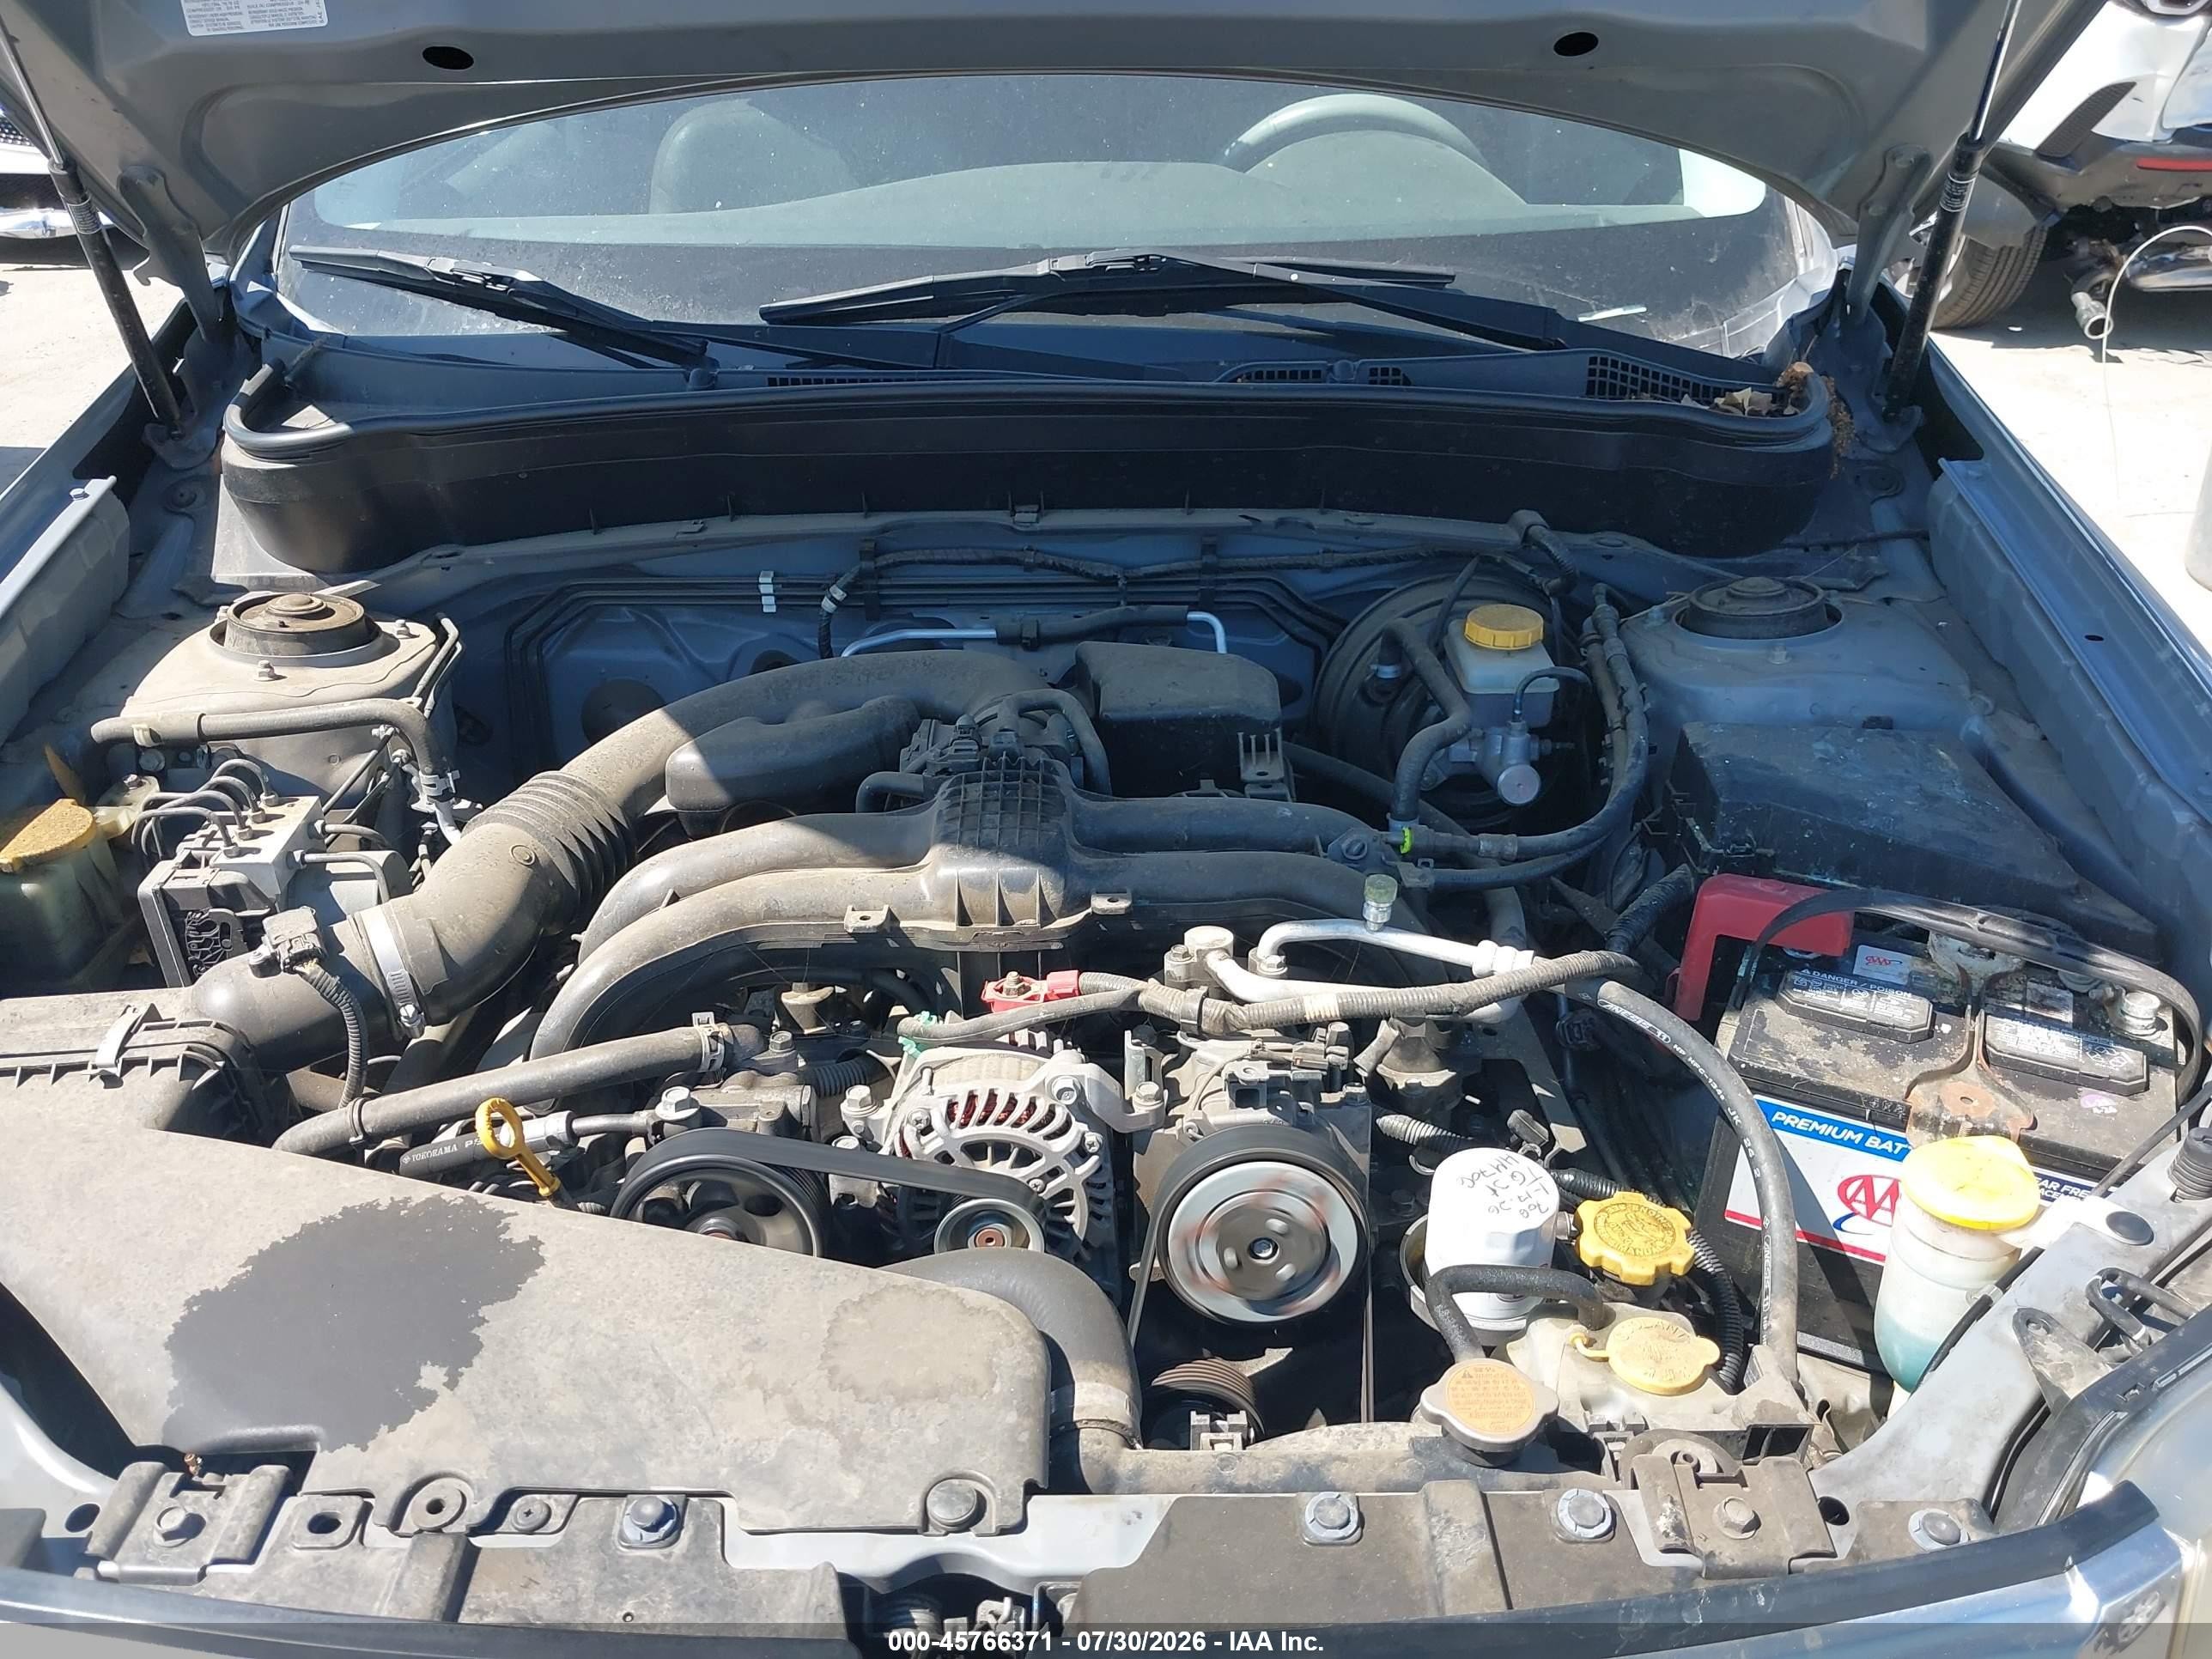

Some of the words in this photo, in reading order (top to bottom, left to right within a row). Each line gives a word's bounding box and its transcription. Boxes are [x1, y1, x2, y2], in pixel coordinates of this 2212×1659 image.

[1812, 970, 1858, 986] DANGER
[1869, 984, 1912, 998] POISON
[1728, 1107, 1742, 1125] JK
[1771, 1111, 1863, 1144] PREMIUM
[411, 1144, 459, 1161] YOKOHAMA
[2061, 1185, 2091, 1199] FRE
